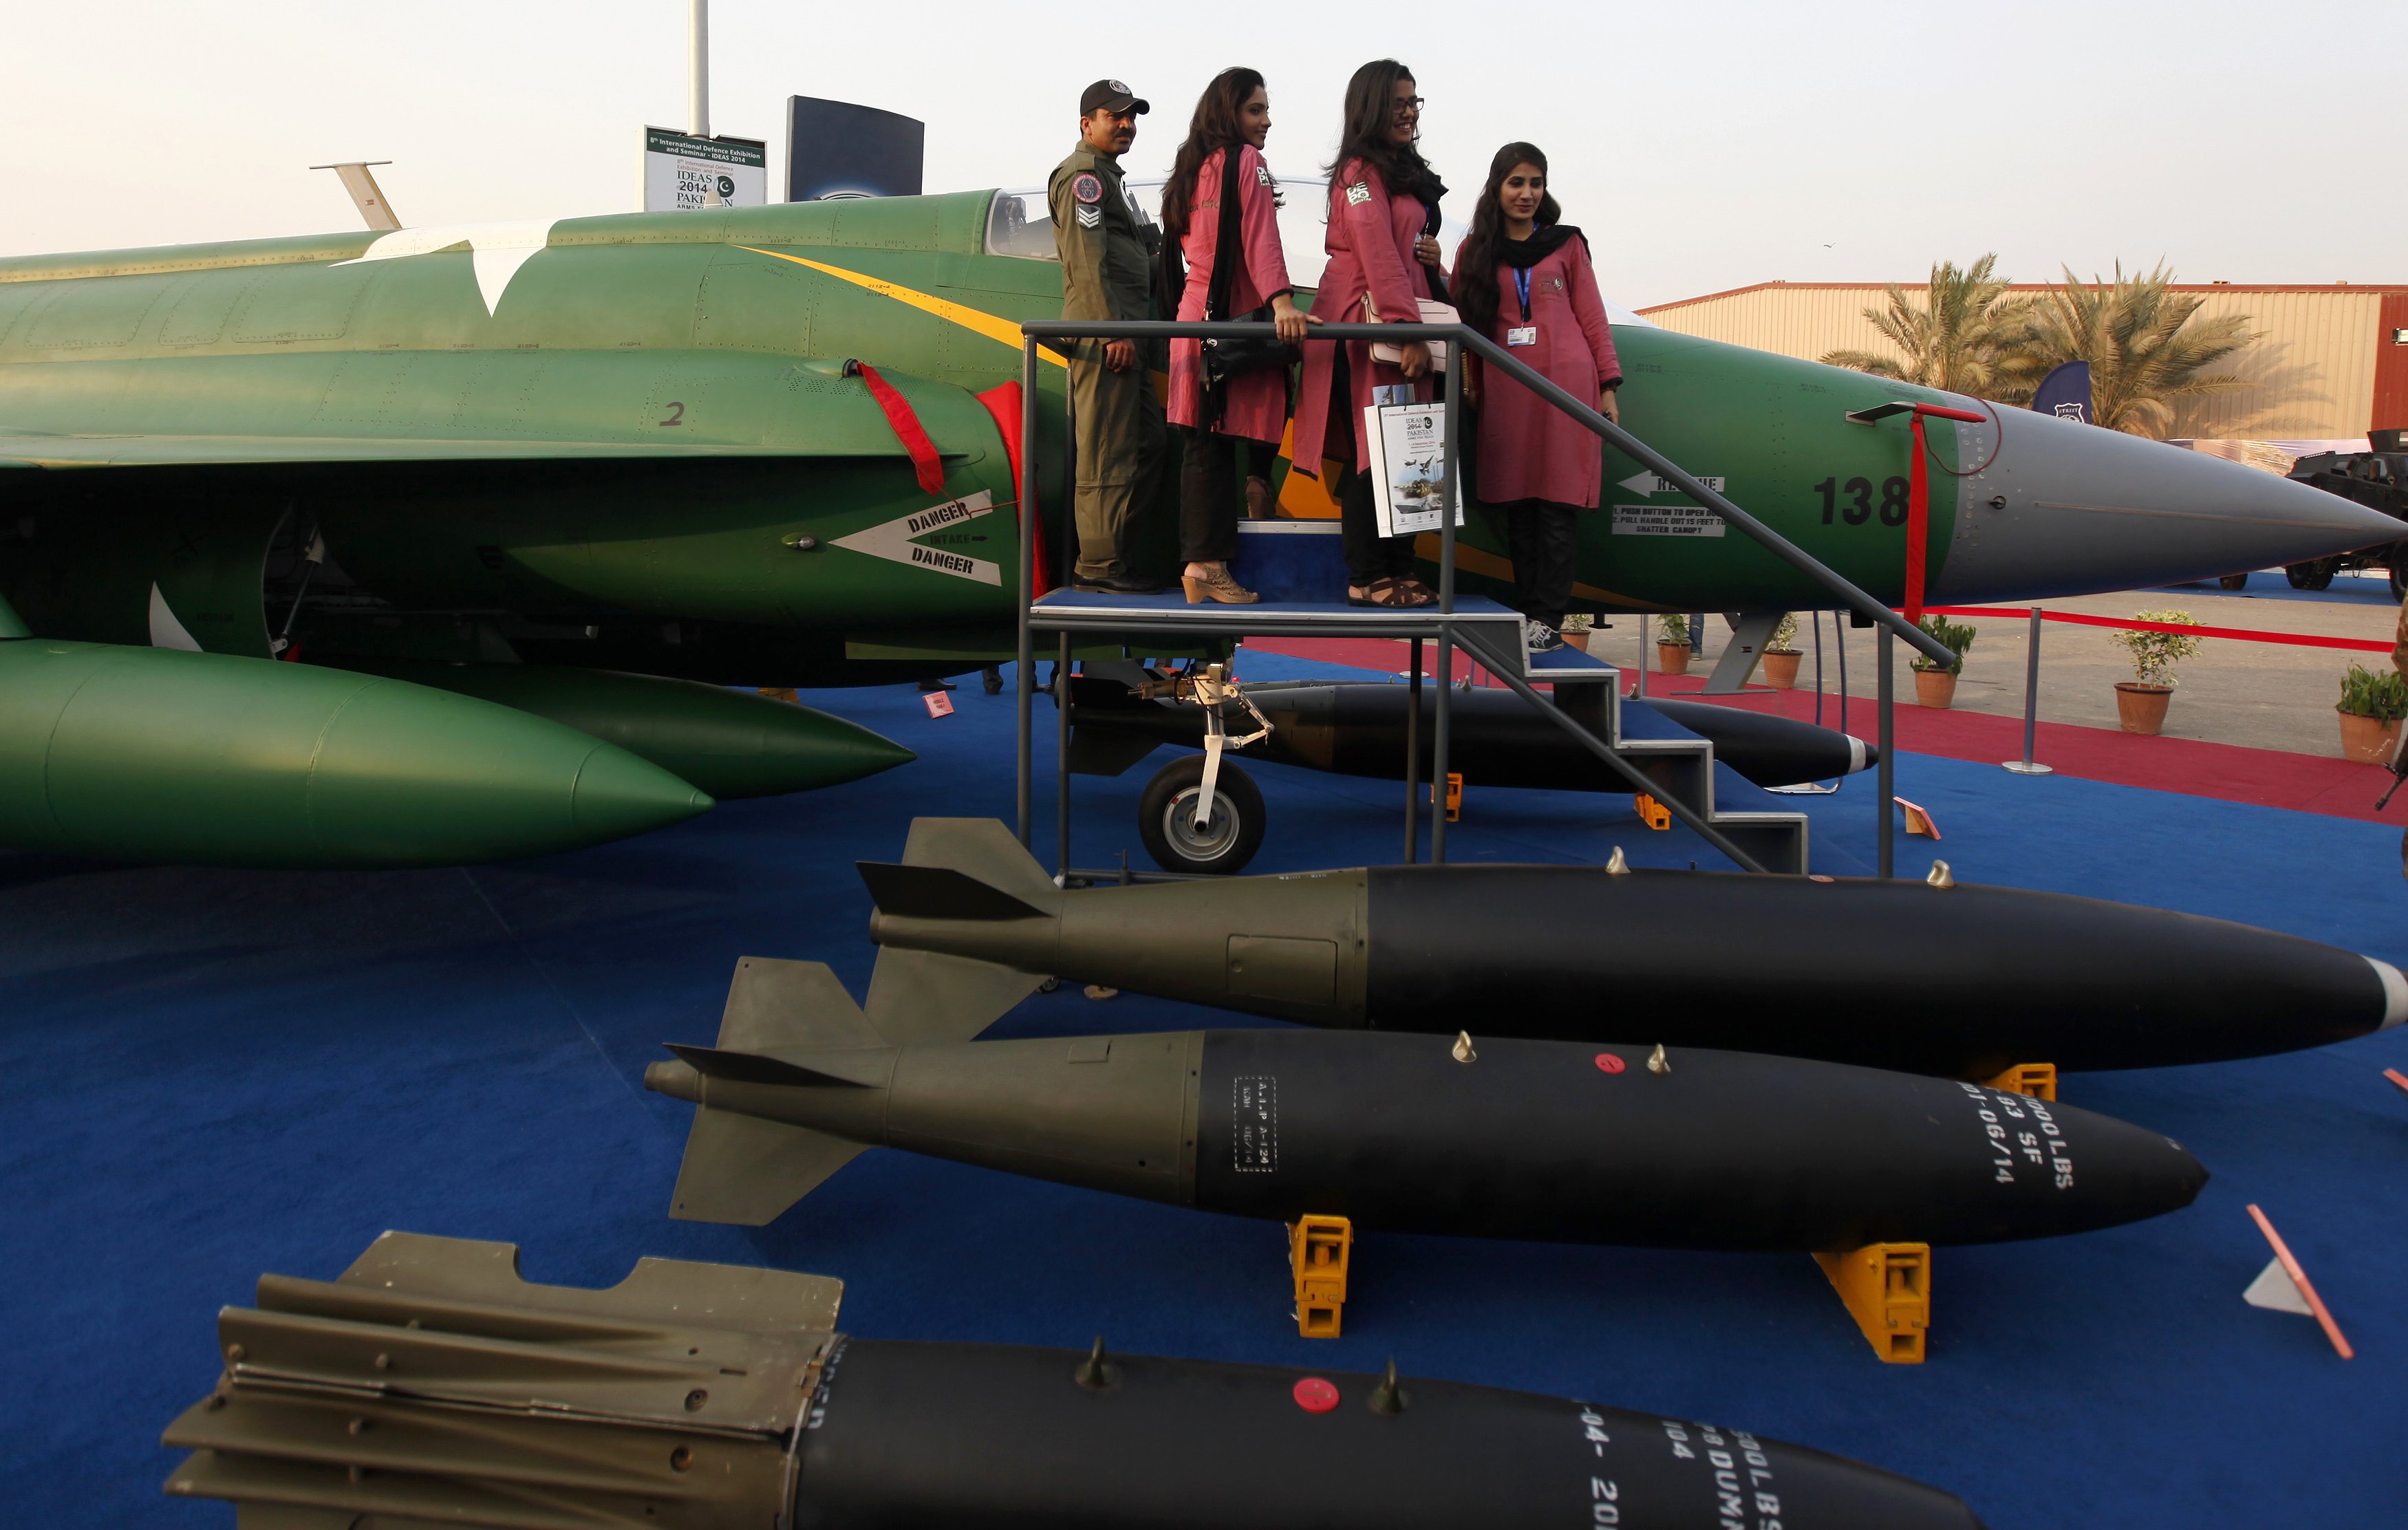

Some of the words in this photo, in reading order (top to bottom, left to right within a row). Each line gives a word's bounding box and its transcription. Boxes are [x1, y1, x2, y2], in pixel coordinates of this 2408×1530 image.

[660, 138, 702, 150] International
[703, 145, 729, 154] Defence
[730, 149, 760, 159] Exhibition
[680, 148, 706, 158] Seminar
[677, 164, 702, 173] Exhibition
[685, 160, 715, 169] International
[677, 171, 712, 183] IDEAS
[679, 181, 708, 193] 2014
[677, 192, 733, 207] PAKIN
[659, 402, 685, 427] 2
[1814, 476, 1911, 527] 138
[907, 502, 970, 533] DANGER
[930, 534, 971, 545] INTAKE
[912, 547, 974, 574] DANGER
[2017, 1131, 2043, 1165] SF
